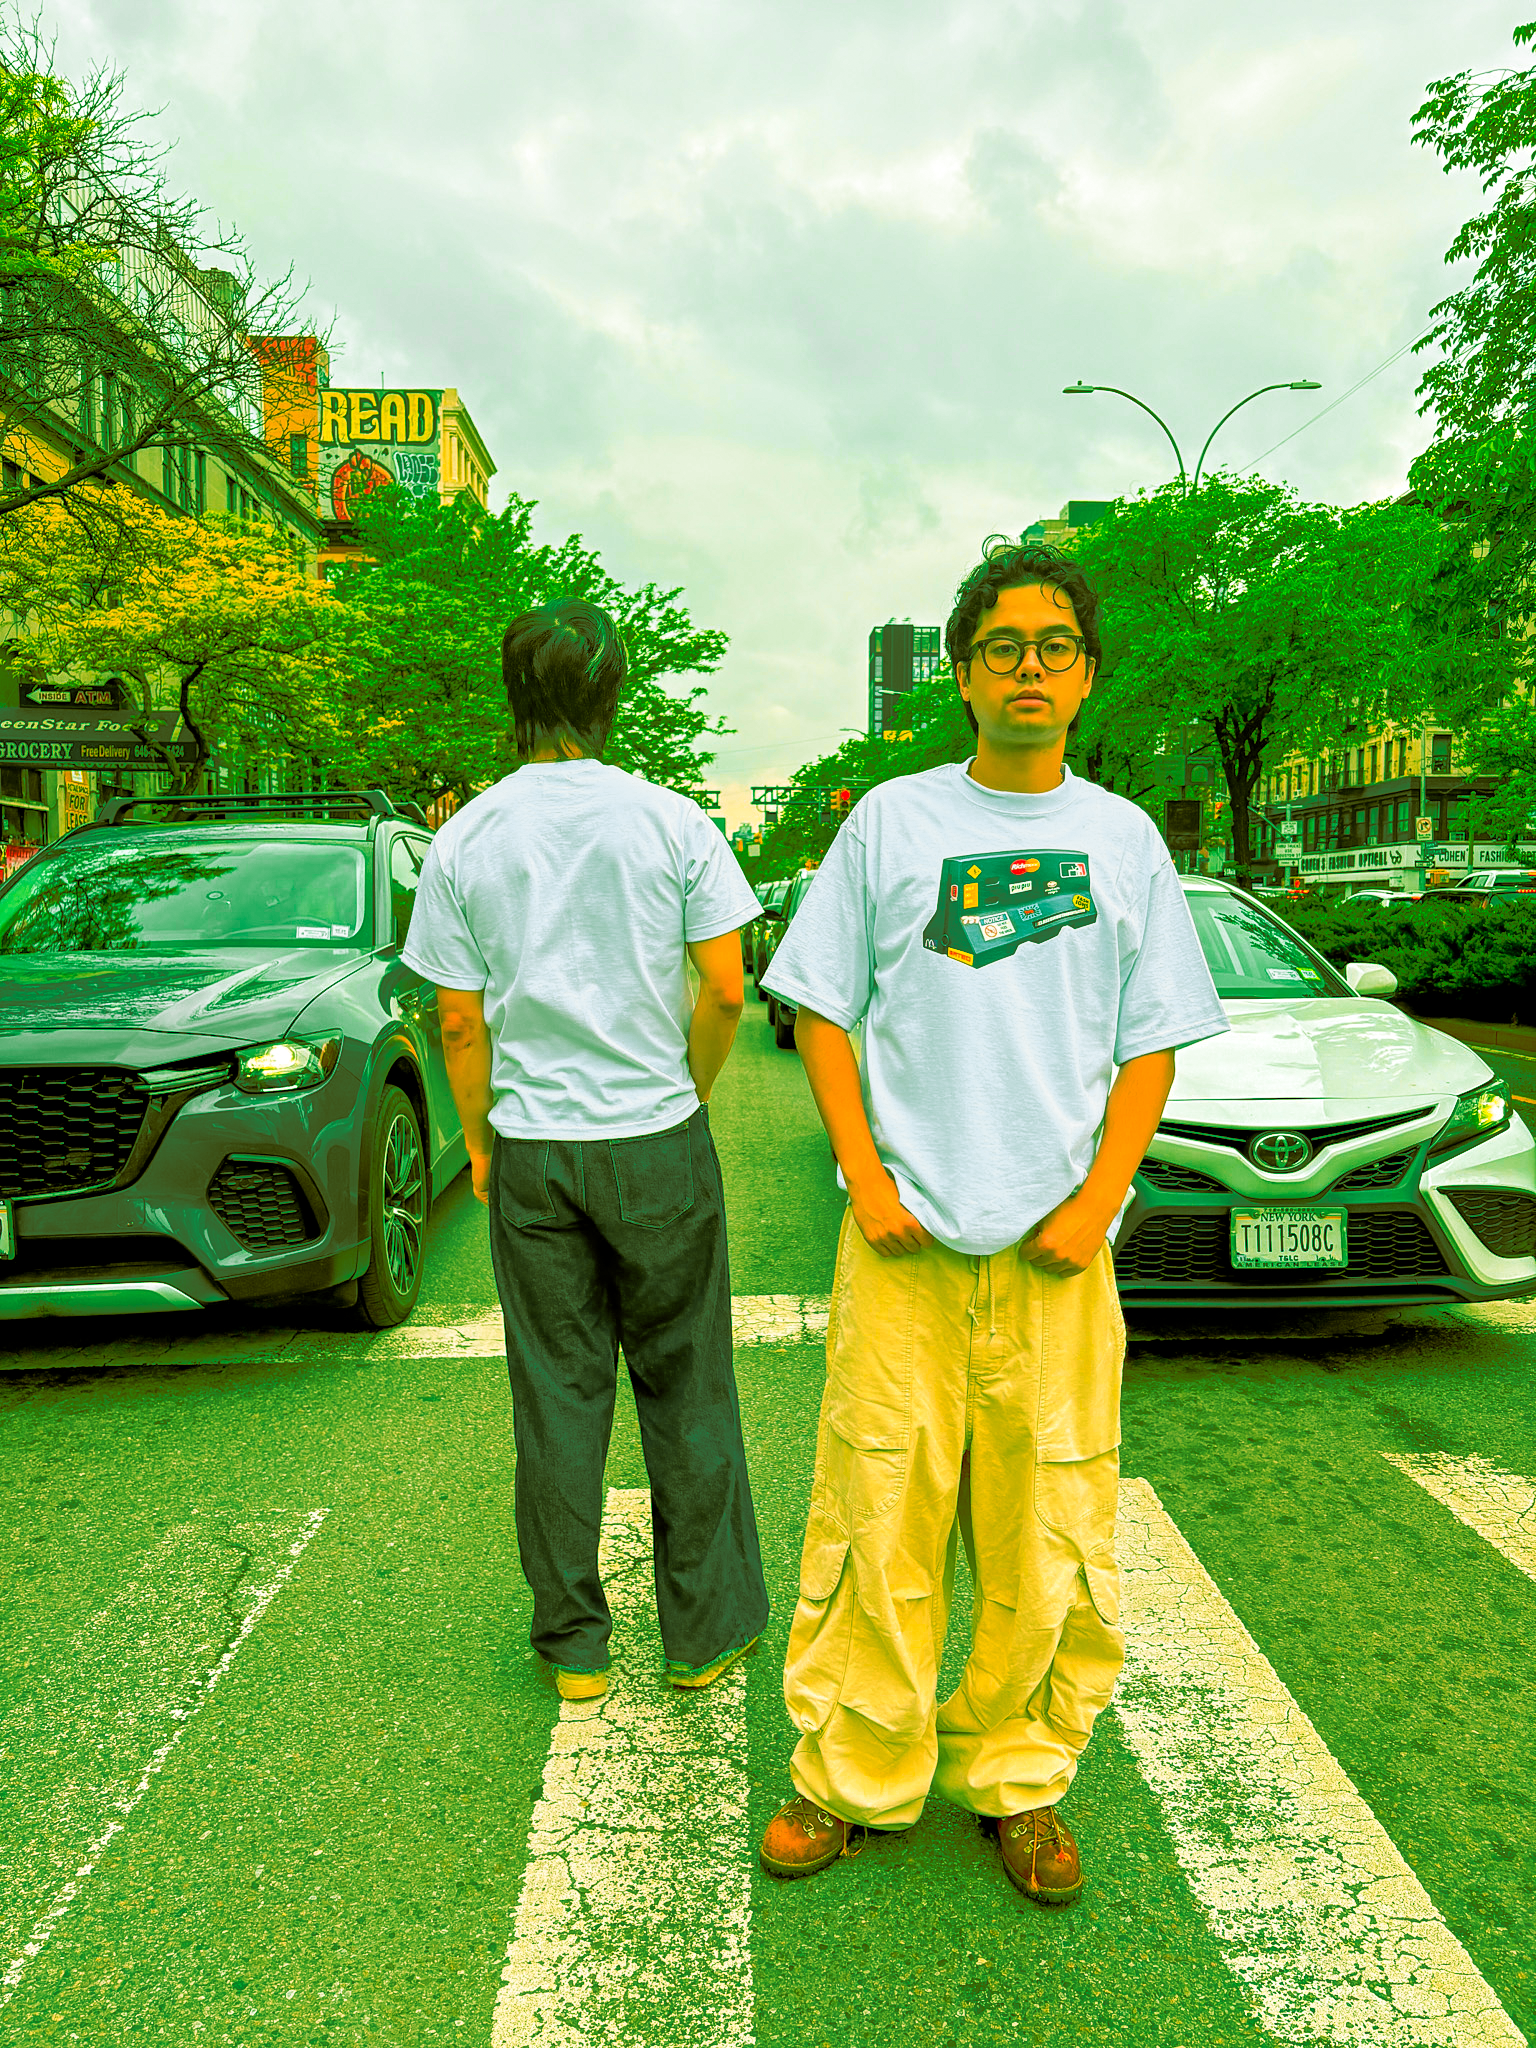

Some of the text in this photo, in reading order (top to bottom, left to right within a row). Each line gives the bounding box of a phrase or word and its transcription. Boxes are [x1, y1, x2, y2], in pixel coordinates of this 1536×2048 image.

[319, 390, 436, 446] READ
[39, 690, 113, 705] INSIDE ATM
[0, 718, 91, 731] eenStar
[69, 794, 86, 811] FOR
[1328, 854, 1356, 870] FASHION
[1358, 851, 1388, 867] OPTICAL
[983, 914, 1005, 925] NOTICE
[1260, 1212, 1317, 1222] NEW YORK
[1241, 1224, 1334, 1253] T111508C
